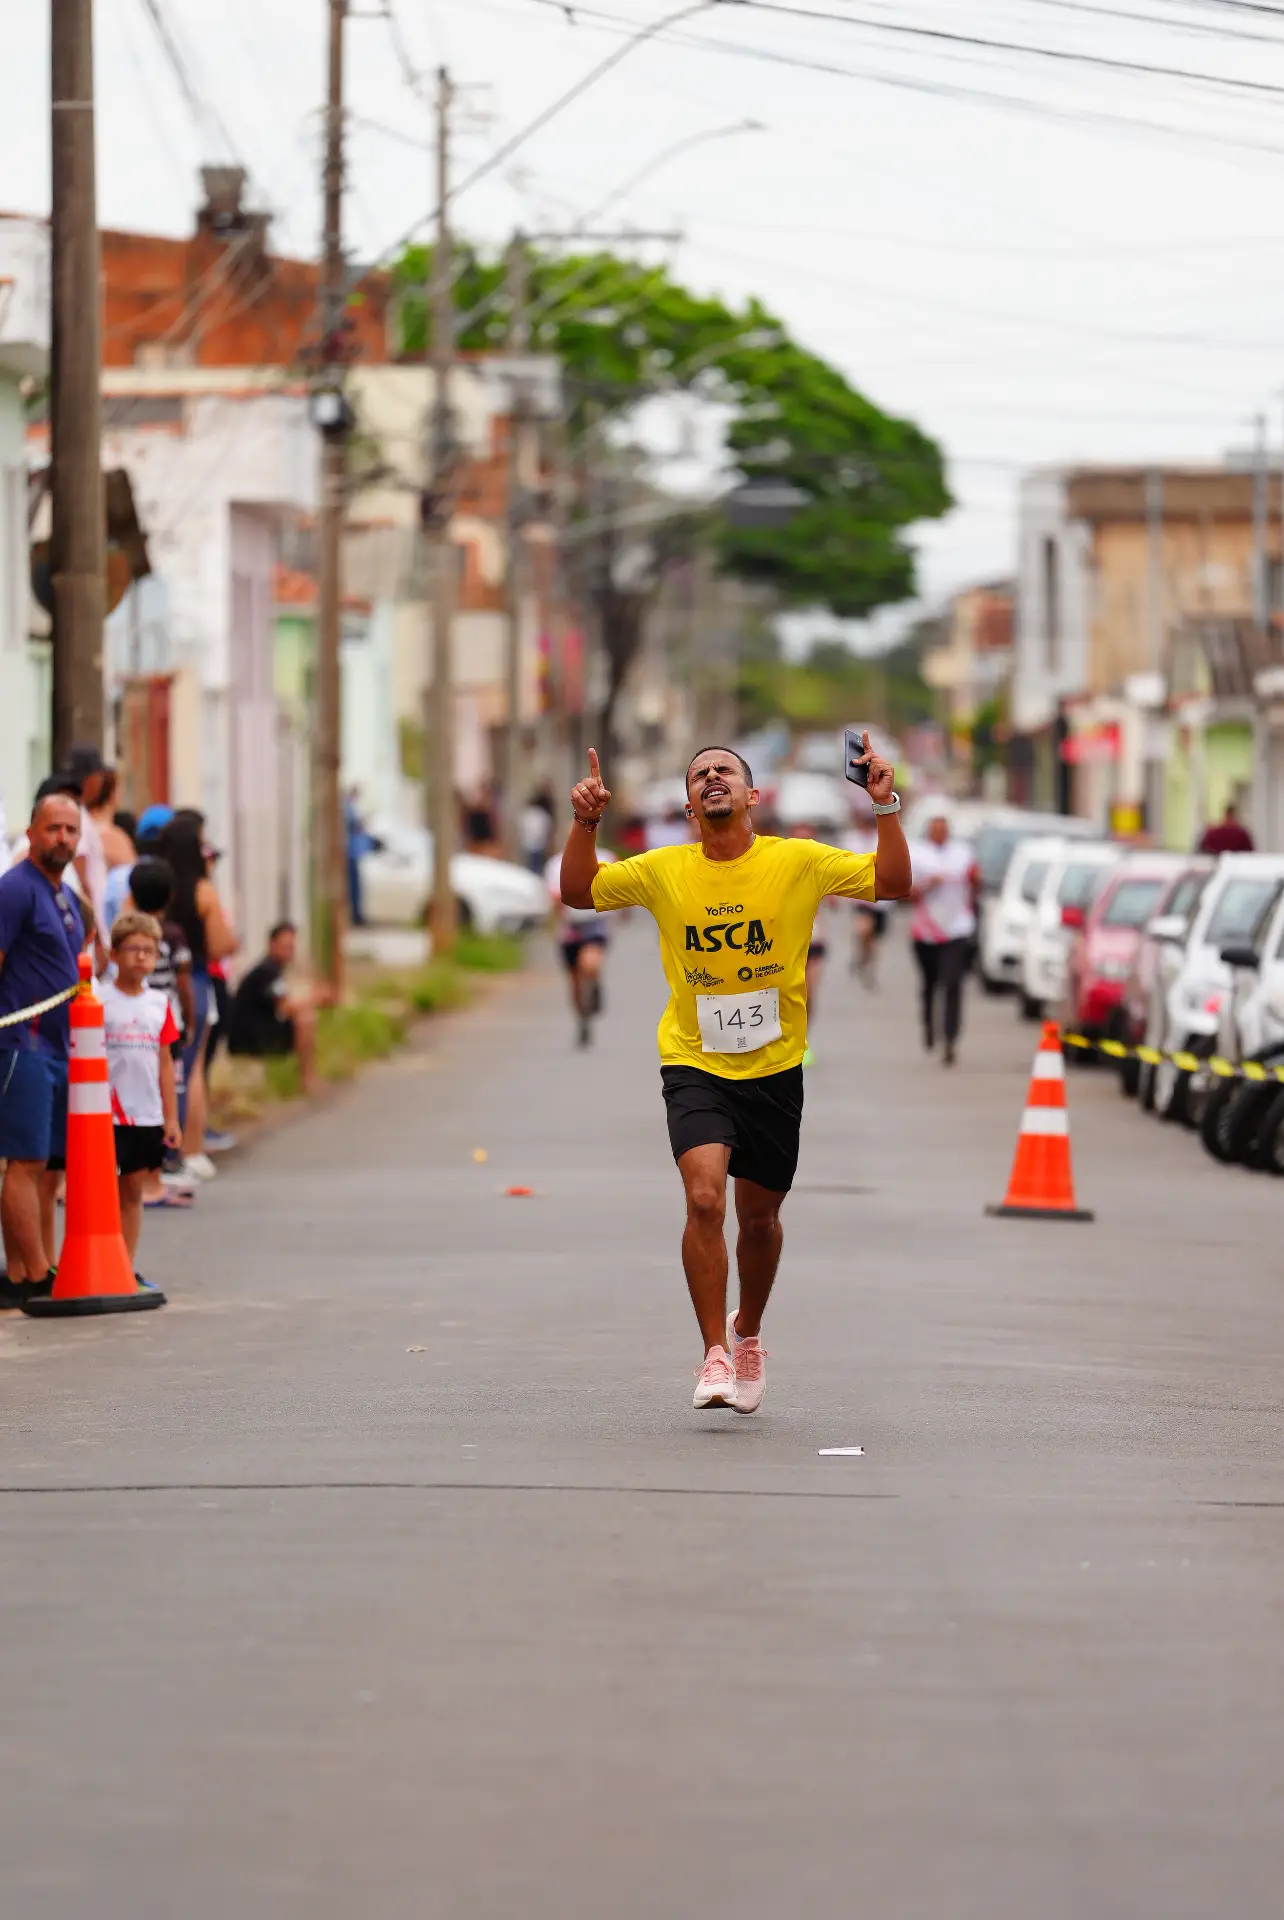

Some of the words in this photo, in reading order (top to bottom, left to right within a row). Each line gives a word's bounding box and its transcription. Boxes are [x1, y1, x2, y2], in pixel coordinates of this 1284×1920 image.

[685, 919, 766, 952] ASCA
[744, 937, 773, 956] RUN
[713, 1004, 765, 1031] 143
